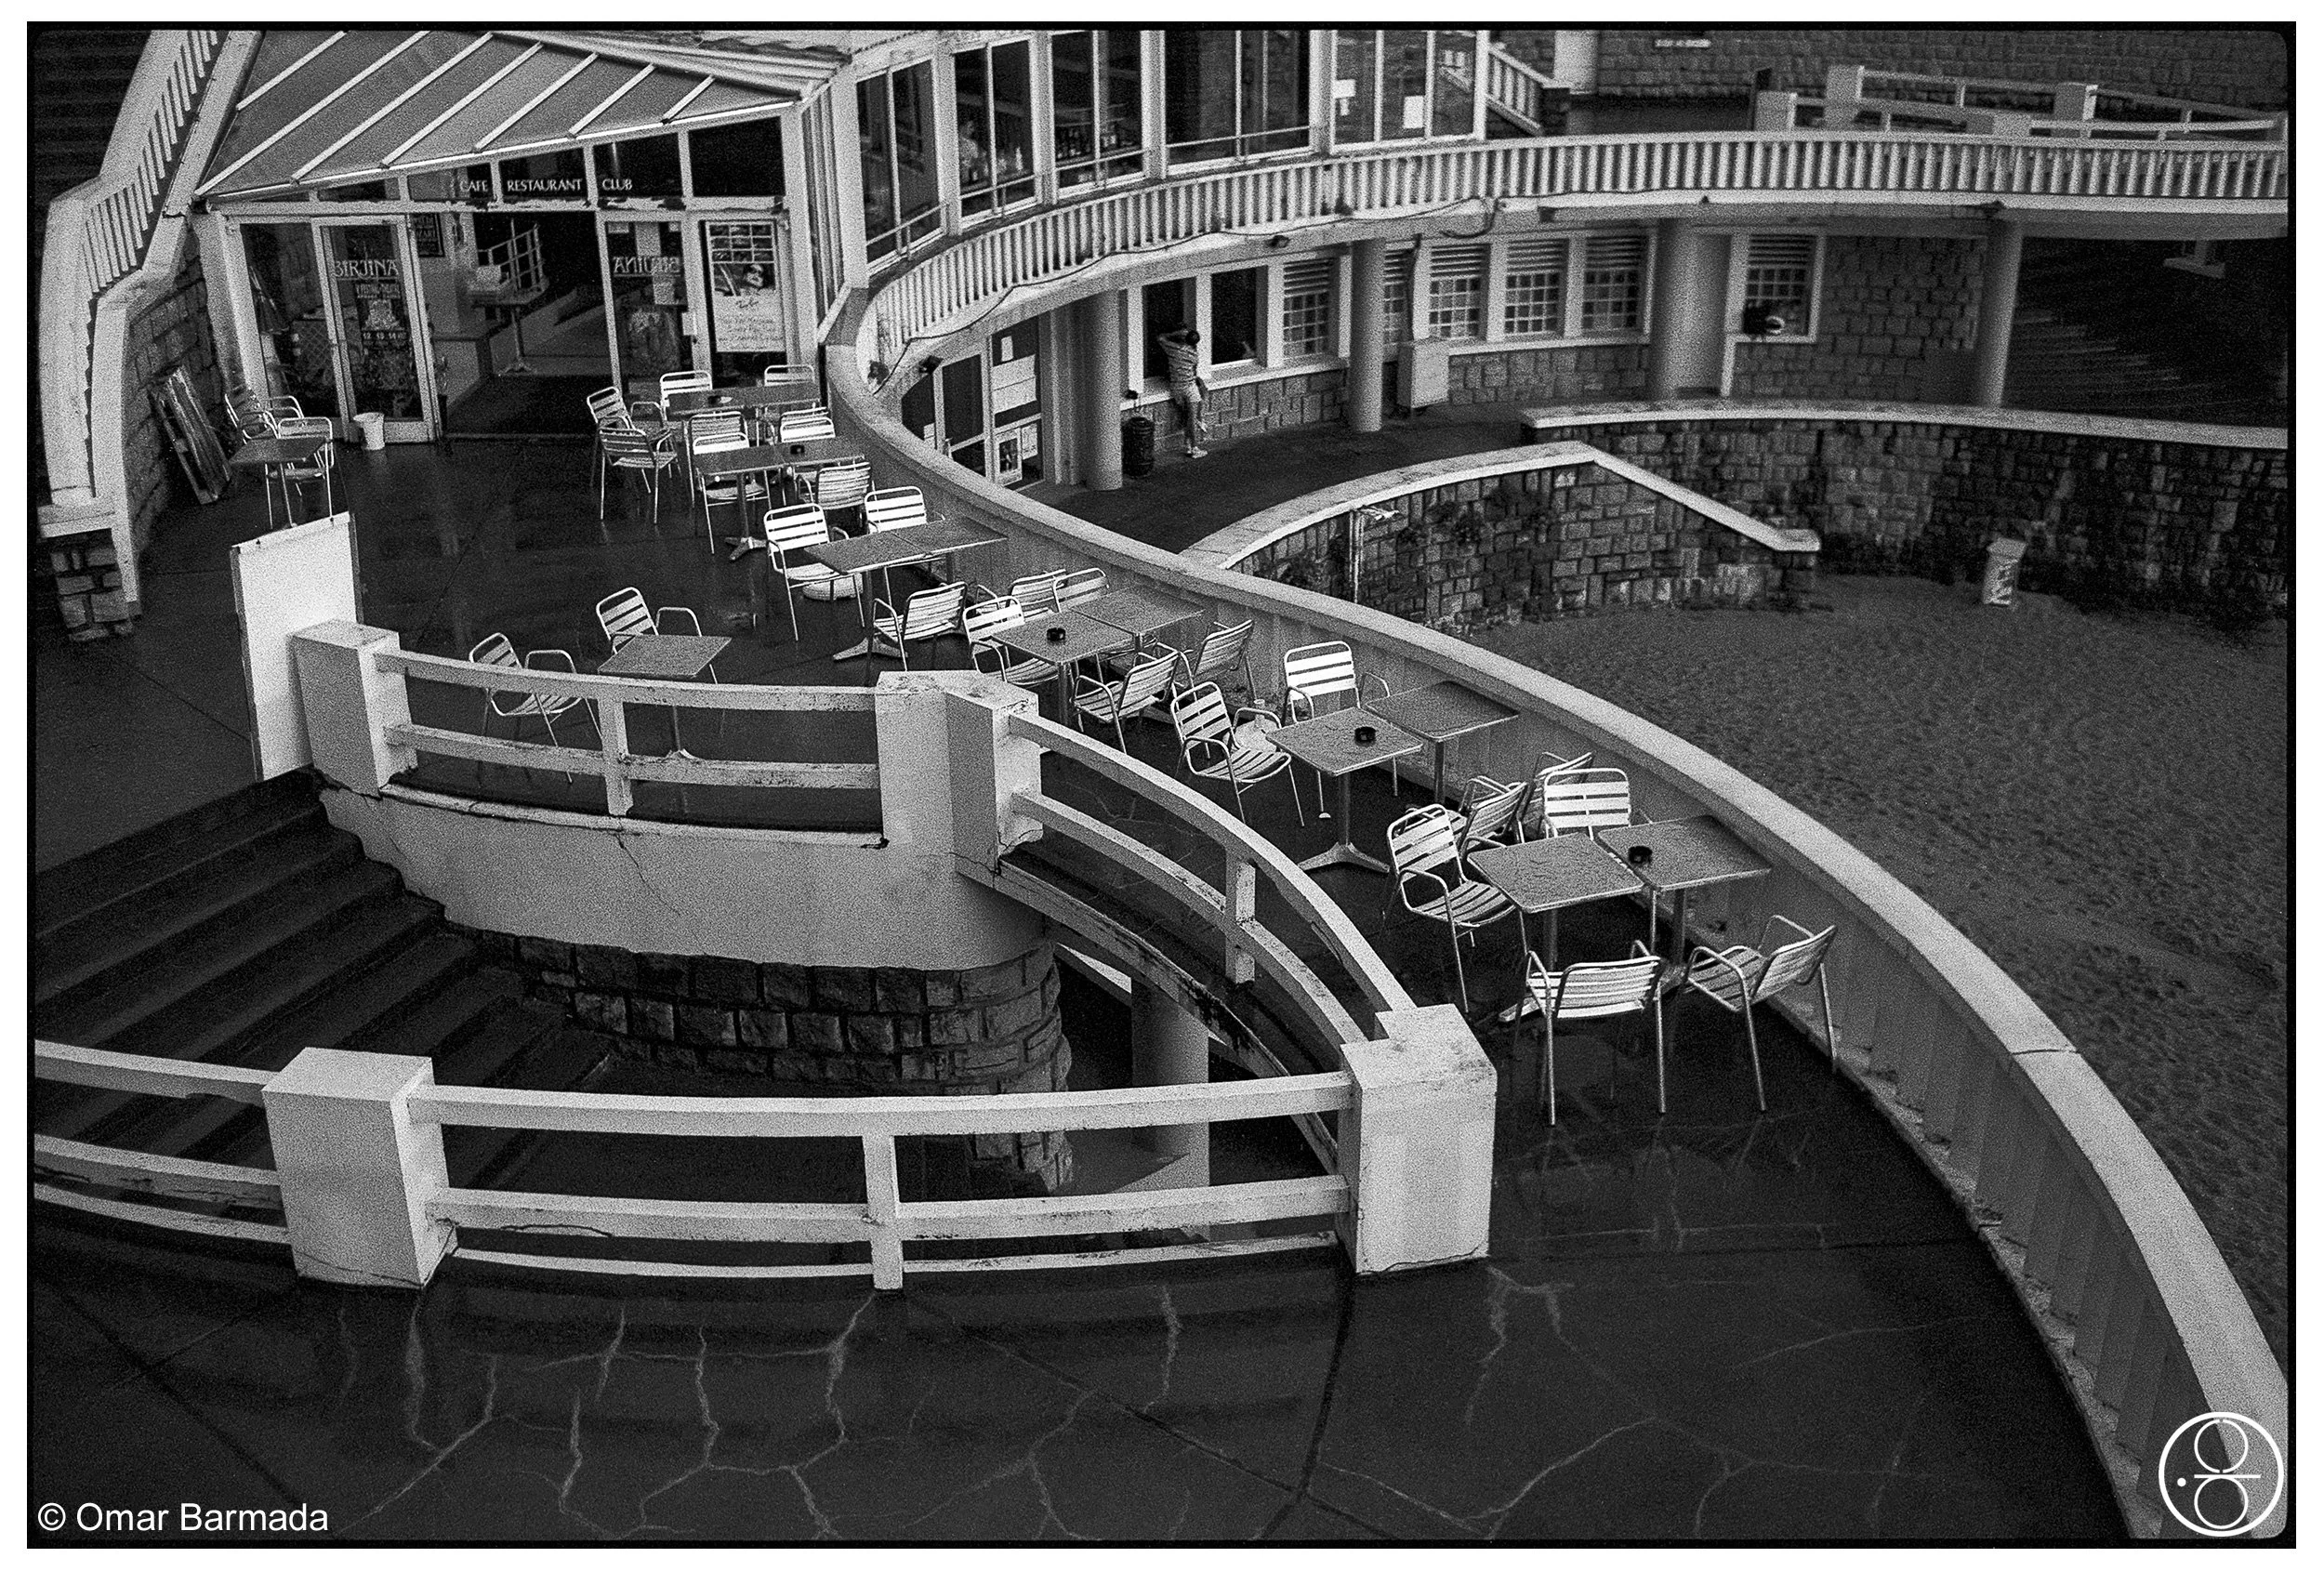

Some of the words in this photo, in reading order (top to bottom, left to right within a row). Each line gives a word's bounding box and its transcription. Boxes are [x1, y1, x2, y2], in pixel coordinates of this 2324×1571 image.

[459, 179, 489, 192] CAFE
[507, 178, 583, 192] RESTAURANT
[601, 178, 633, 191] CLUB
